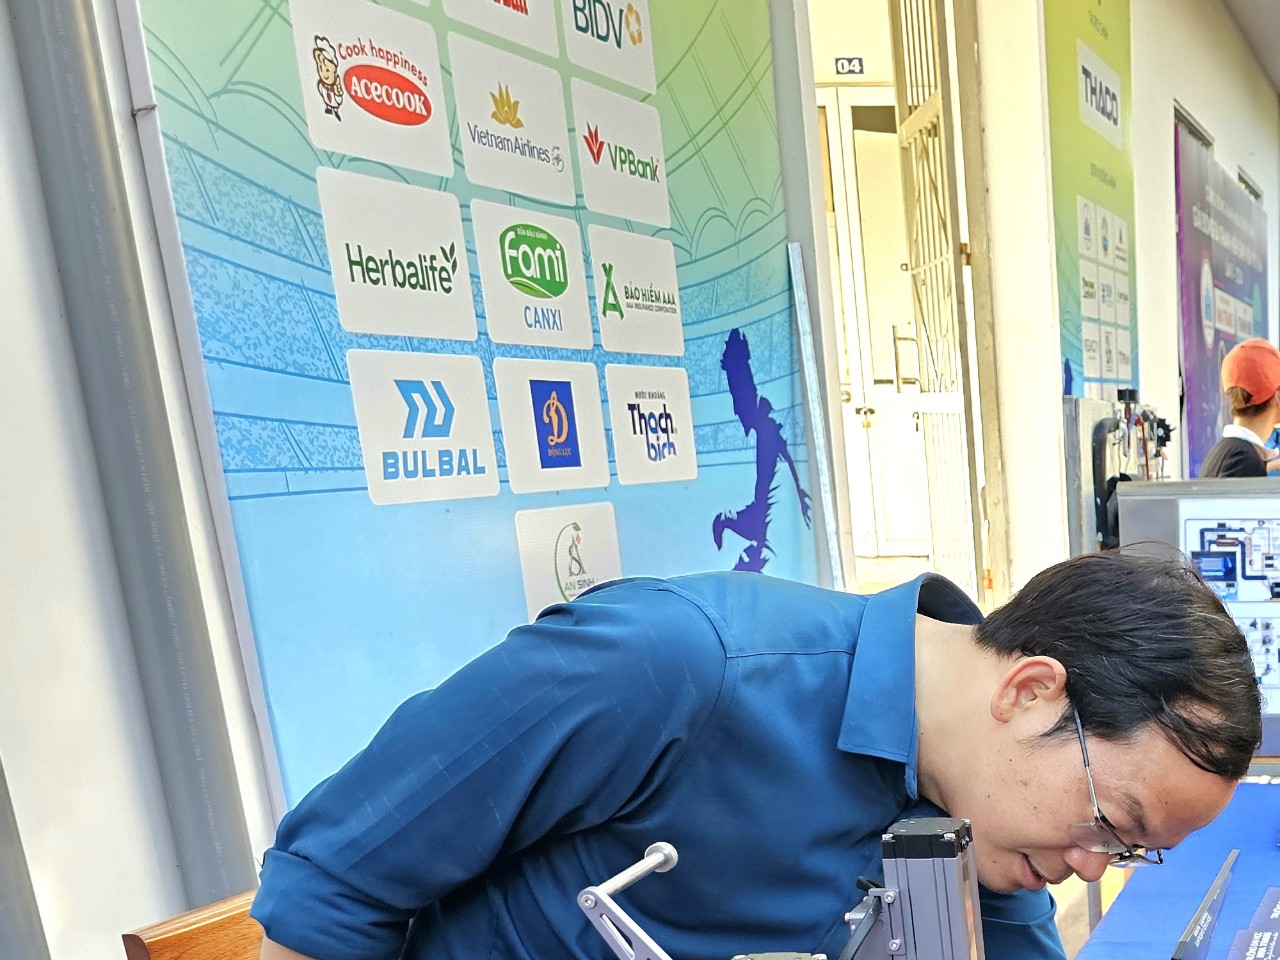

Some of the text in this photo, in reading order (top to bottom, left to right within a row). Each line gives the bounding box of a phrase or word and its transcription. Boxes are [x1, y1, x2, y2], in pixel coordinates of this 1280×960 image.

[573, 0, 624, 49] BIDV
[338, 37, 429, 87] Cook happiness
[837, 58, 862, 74] 04
[1081, 64, 1119, 127] THACO
[607, 142, 660, 183] VPBank
[345, 243, 453, 294] Herbalife
[624, 280, 676, 306] BẢO HIỂM AAA
[524, 305, 563, 331] CANXI
[382, 448, 486, 481] BULBAL
[565, 578, 595, 591] AN SINH
